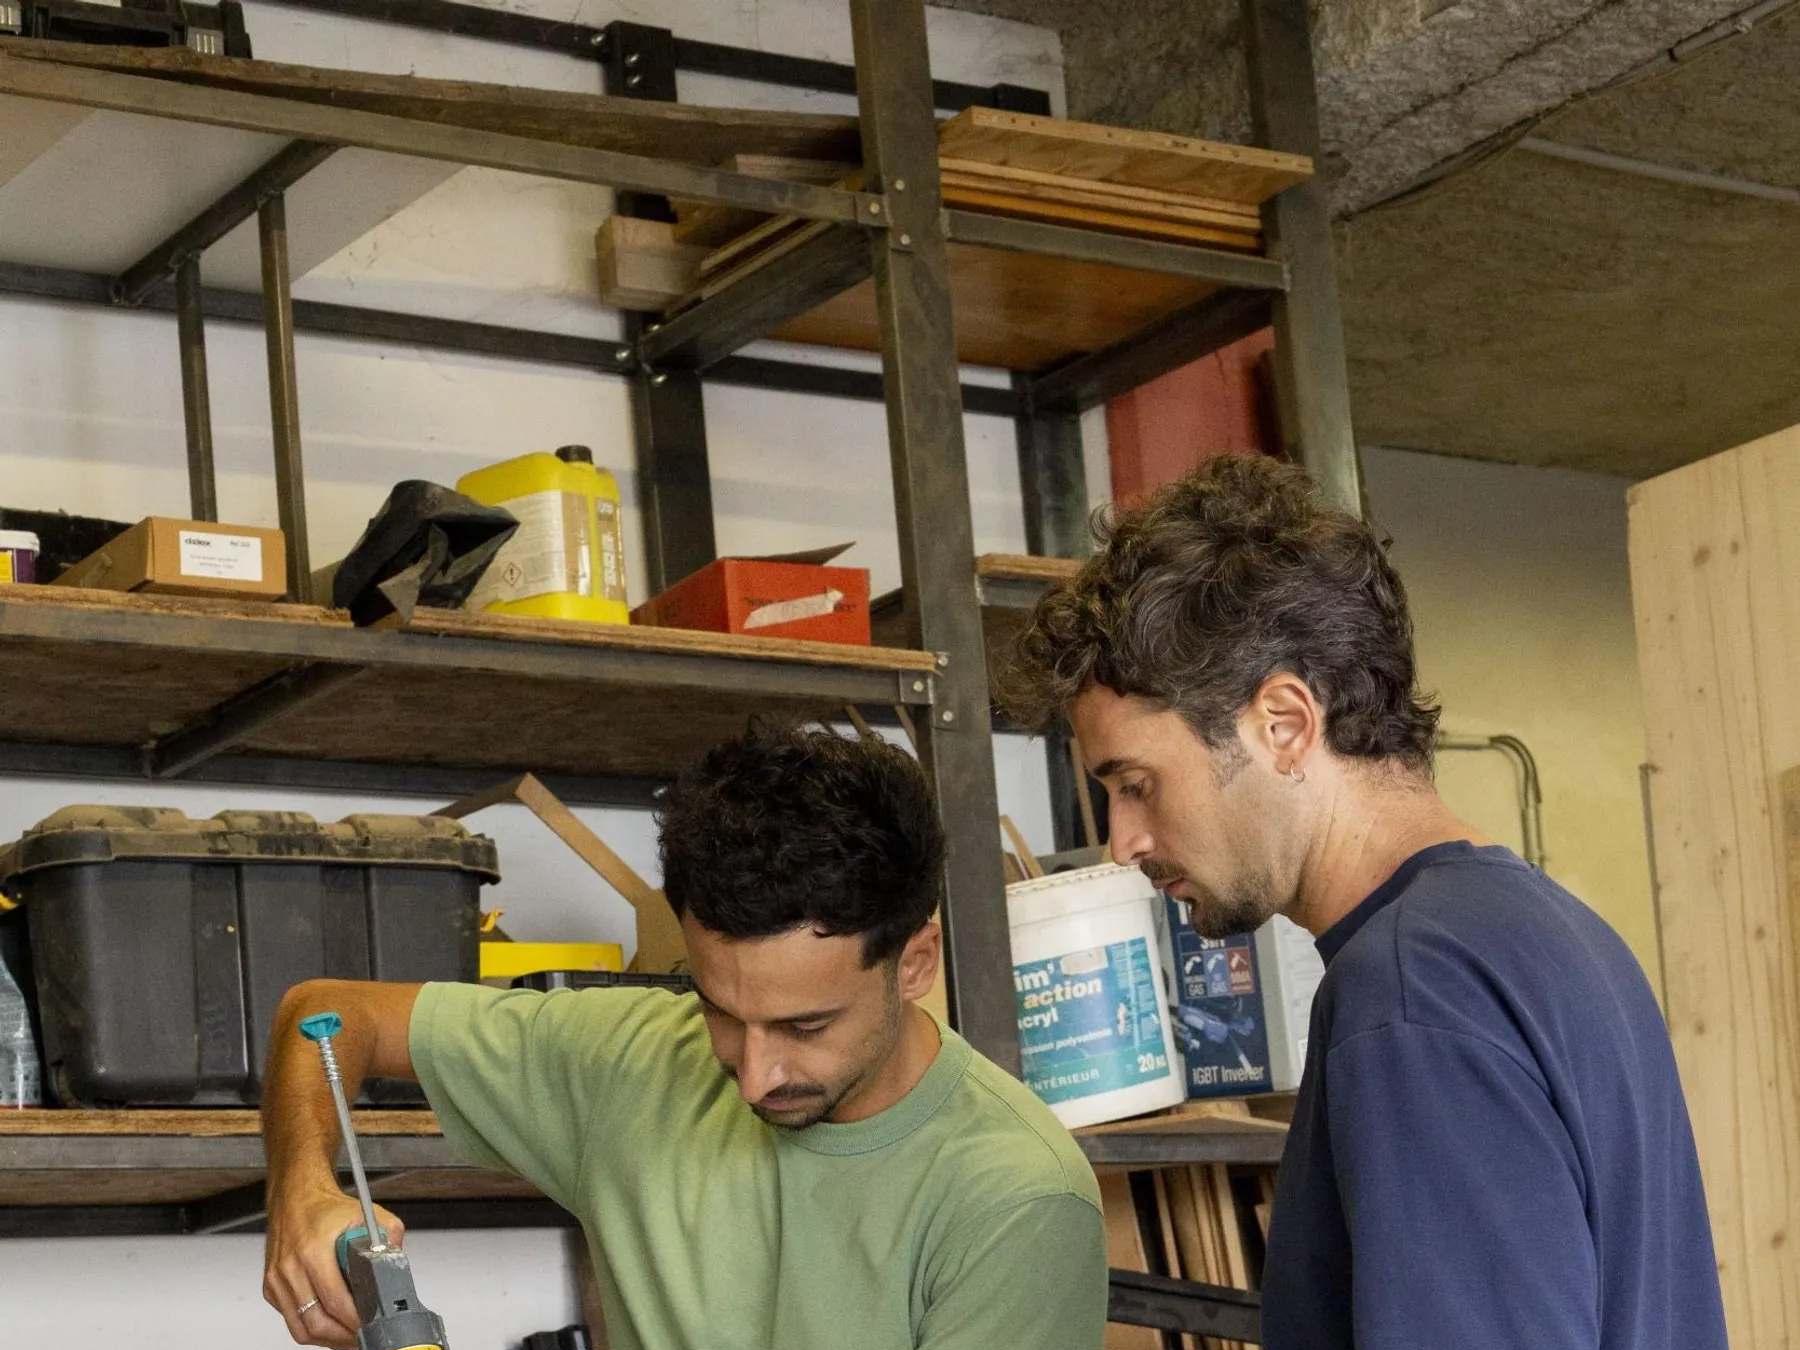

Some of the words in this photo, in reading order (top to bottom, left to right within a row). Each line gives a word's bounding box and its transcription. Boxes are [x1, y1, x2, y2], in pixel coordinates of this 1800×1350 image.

[1024, 978, 1102, 1009] action
[1137, 1052, 1155, 1073] 20
[1193, 1066, 1218, 1085] IGBT
